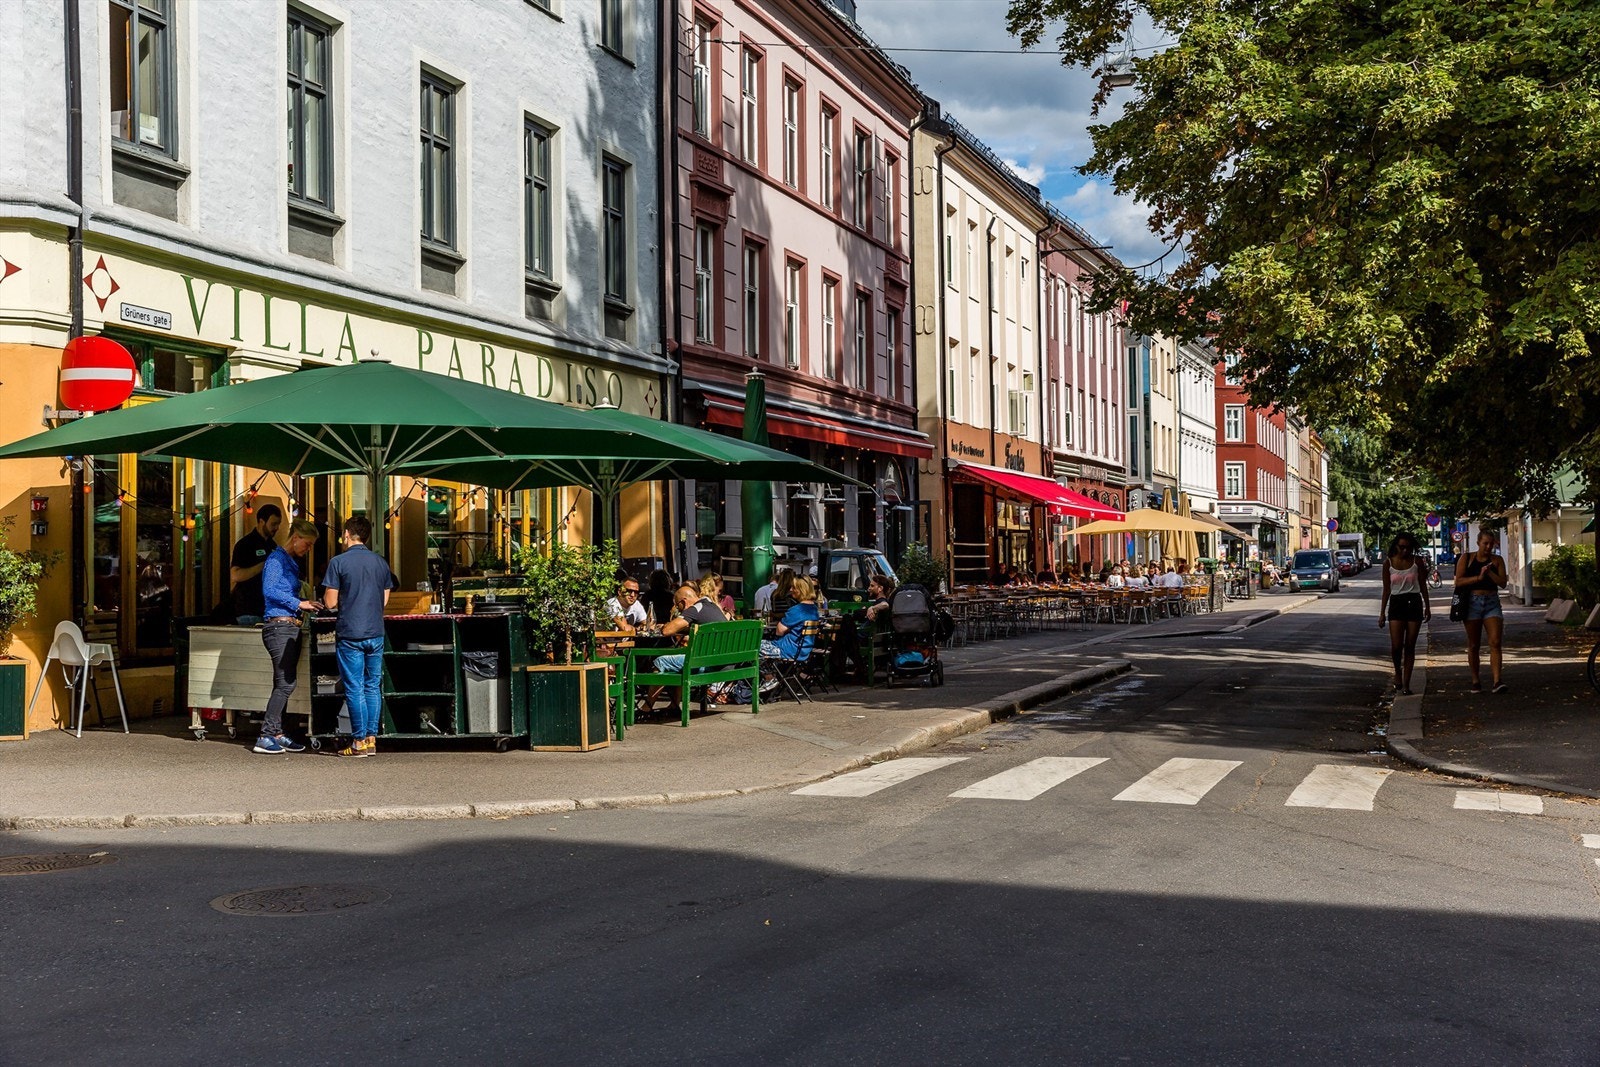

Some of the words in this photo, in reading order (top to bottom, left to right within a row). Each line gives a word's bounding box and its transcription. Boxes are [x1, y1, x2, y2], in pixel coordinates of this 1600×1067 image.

[125, 307, 150, 322] Grüners
[153, 315, 168, 326] gate
[180, 275, 359, 363] VILLA
[416, 328, 623, 410] PARADISO
